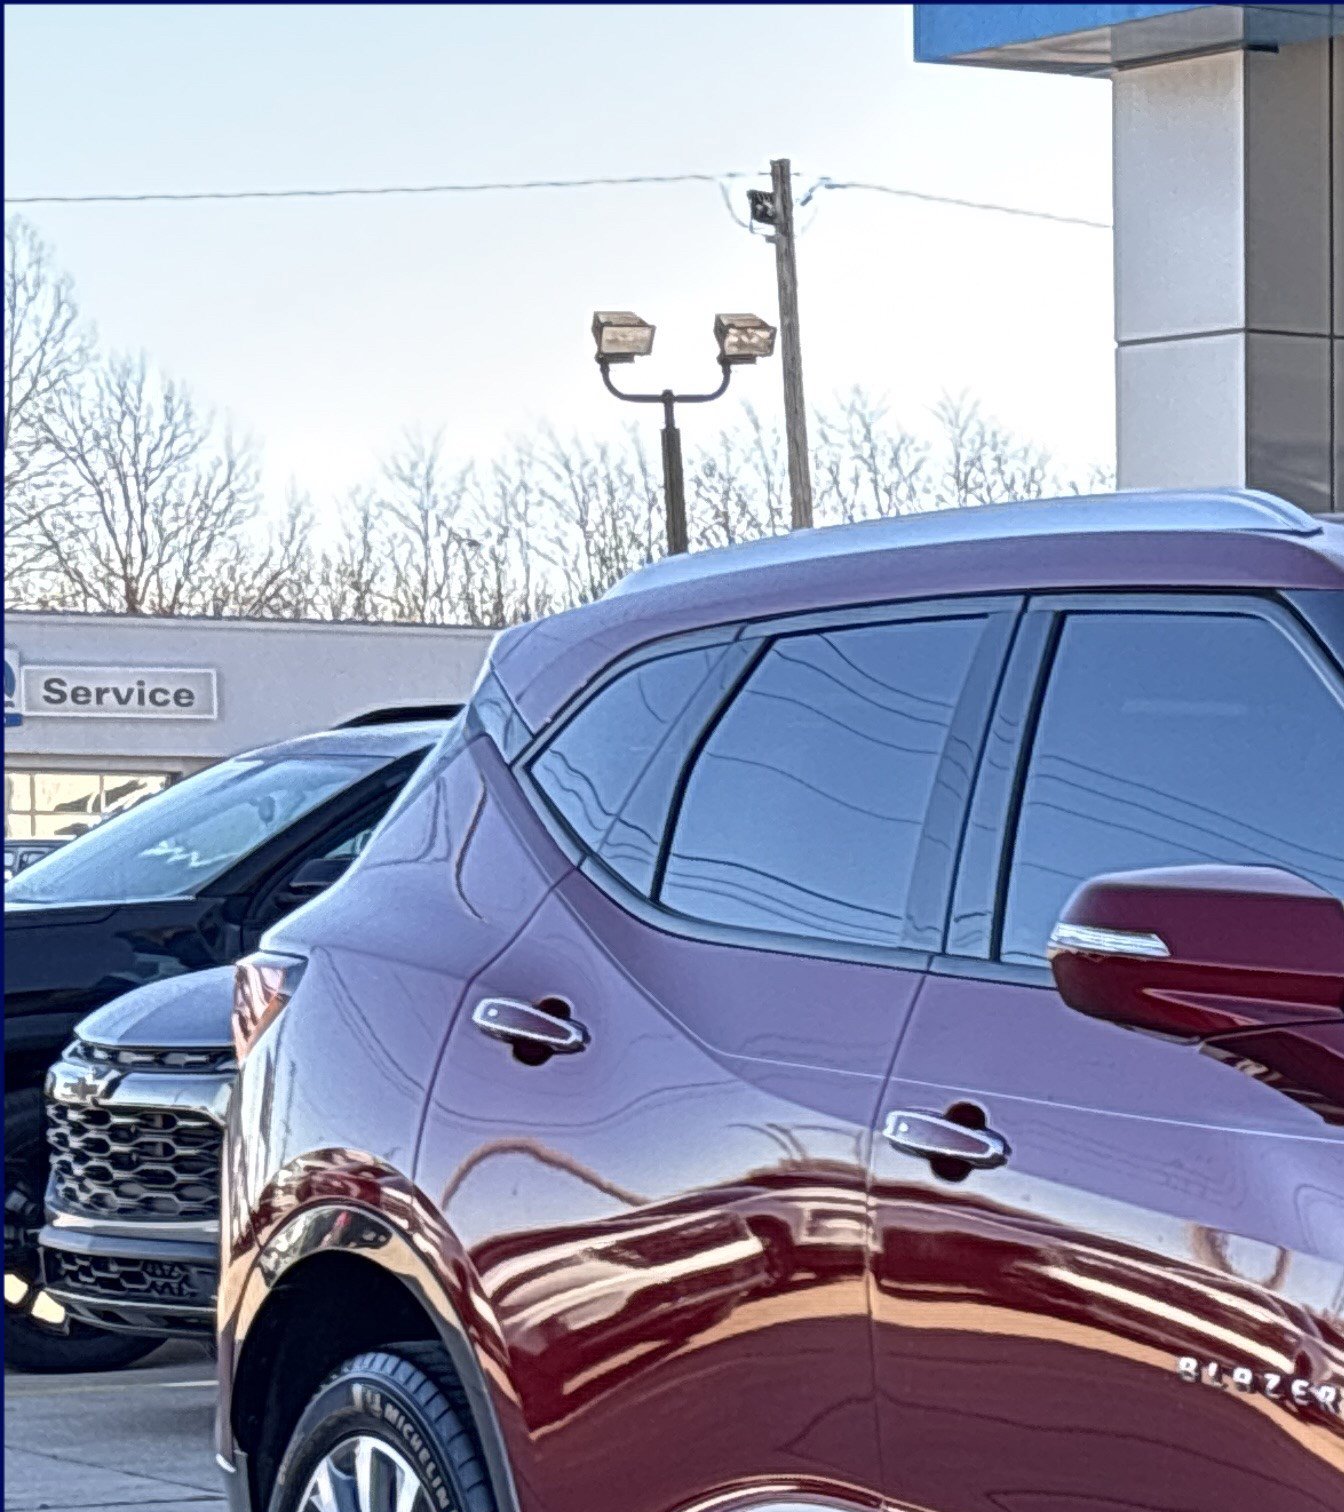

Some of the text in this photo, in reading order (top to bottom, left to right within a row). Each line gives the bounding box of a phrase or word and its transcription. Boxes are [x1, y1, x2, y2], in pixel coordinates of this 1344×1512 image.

[42, 677, 195, 708] Service
[1176, 1355, 1342, 1414] BLAZER
[383, 1402, 451, 1510] MICHELIN
